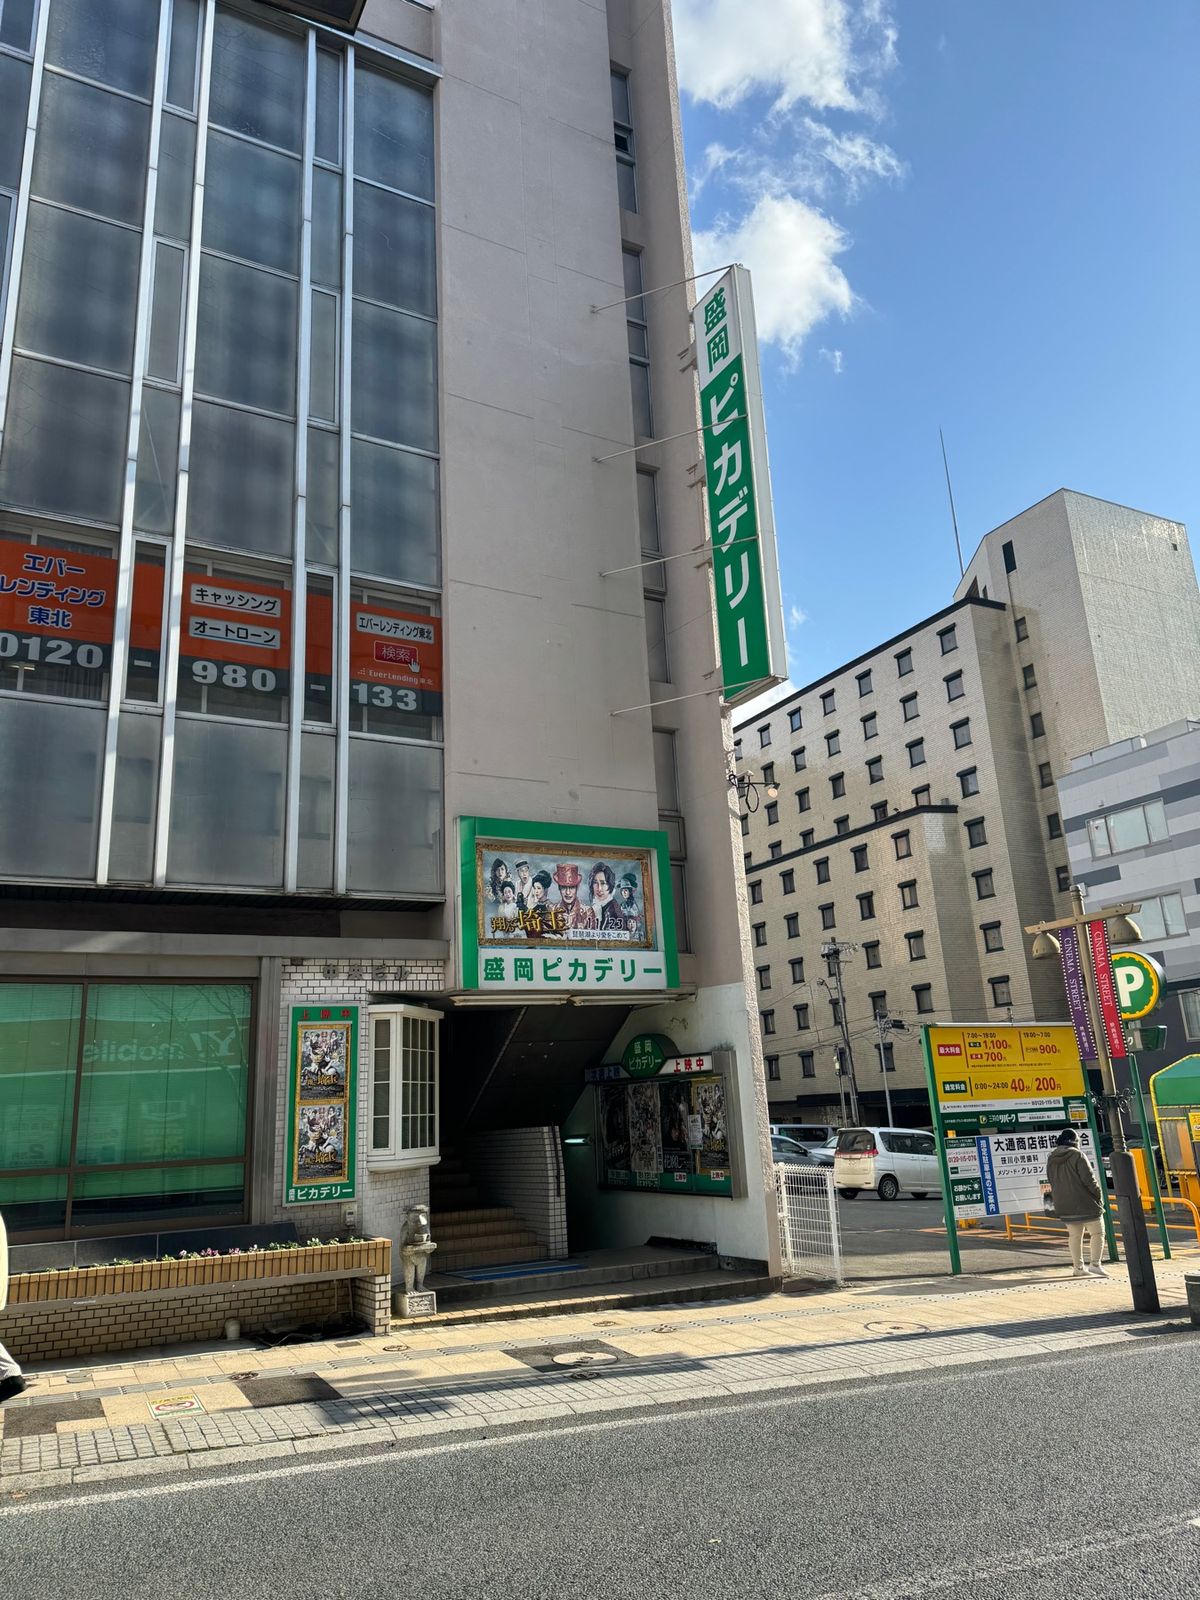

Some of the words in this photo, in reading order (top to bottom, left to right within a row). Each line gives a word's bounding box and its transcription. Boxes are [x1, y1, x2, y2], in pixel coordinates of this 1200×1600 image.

[704, 287, 749, 667] 盛岡ピカデリー
[23, 553, 85, 576] エバー
[0, 575, 106, 607] レンディング
[195, 587, 277, 612] キャッシング
[28, 606, 72, 629] 東北
[359, 617, 432, 640] エバーレンディング東北
[194, 620, 276, 644] オートローン
[382, 645, 410, 662] 検索
[192, 660, 276, 692] 980
[353, 682, 417, 711] 133
[587, 918, 623, 931] 11/23
[484, 957, 662, 982] 盛岡ピカデリー
[1063, 937, 1075, 973] CINEMA
[1069, 978, 1082, 1011] STREET
[1094, 931, 1106, 968] CINEMA
[1100, 973, 1113, 1007] STREET
[1115, 966, 1144, 1007] P
[633, 1040, 652, 1054] 盛岡
[628, 1055, 662, 1070] ピカデリー
[674, 1058, 704, 1073] 上映中
[297, 1187, 353, 1201] ピカデリー
